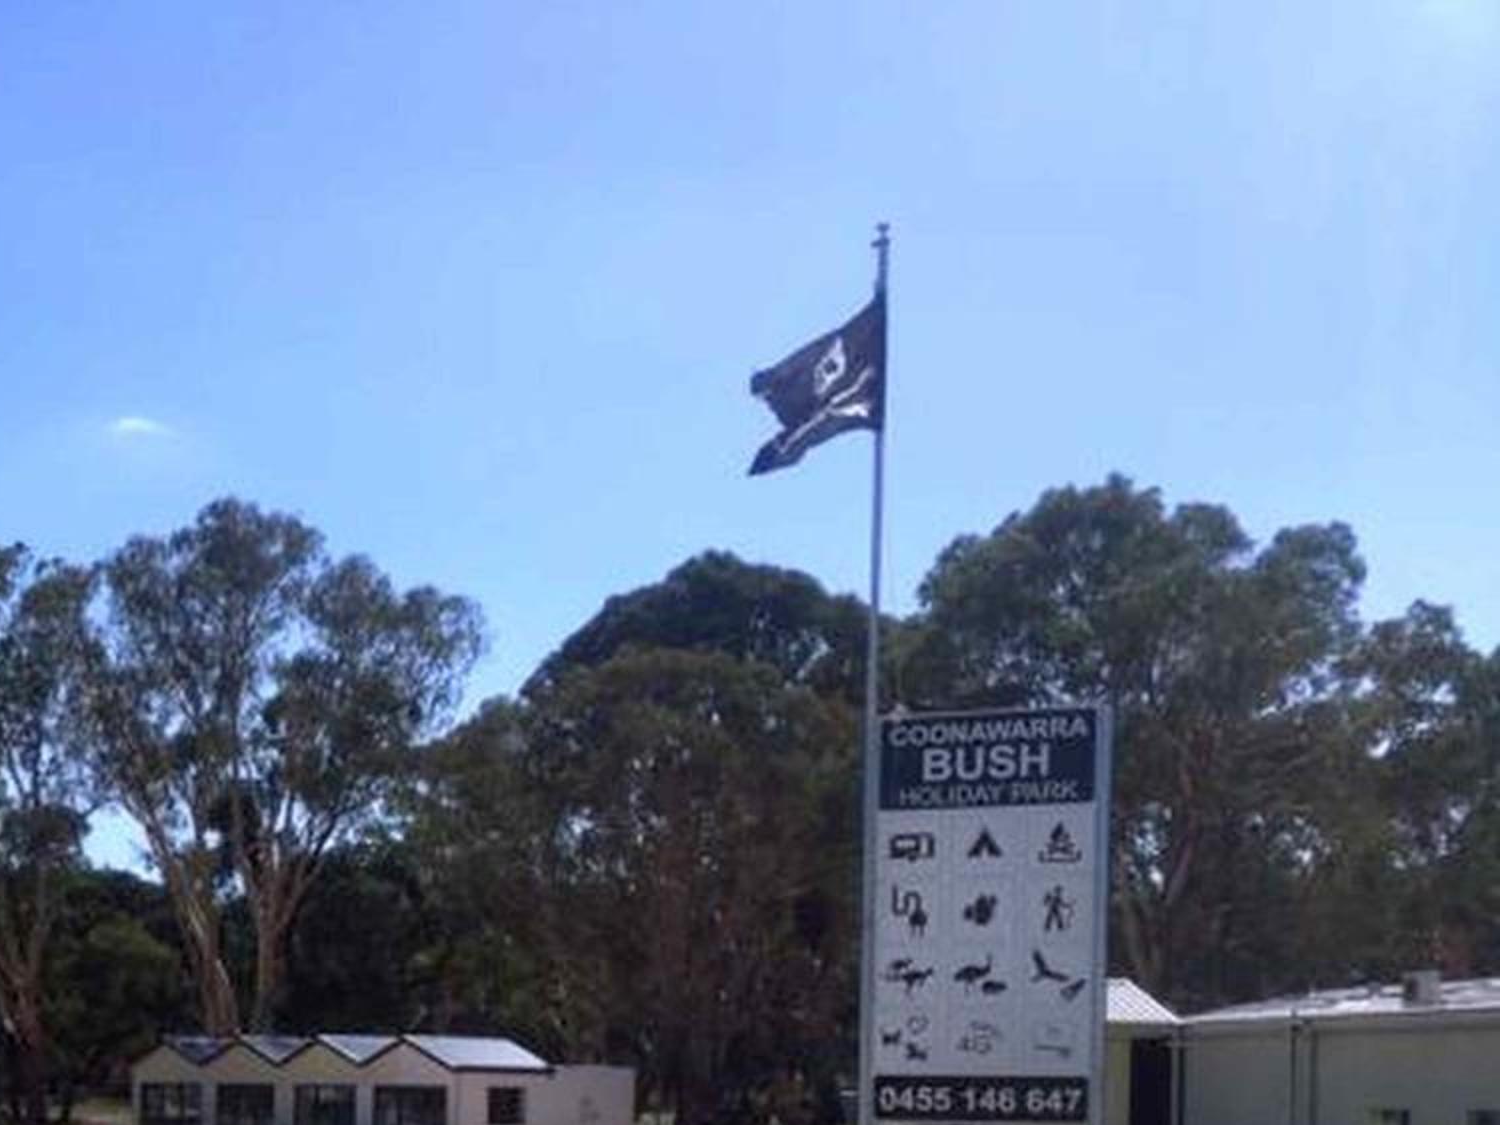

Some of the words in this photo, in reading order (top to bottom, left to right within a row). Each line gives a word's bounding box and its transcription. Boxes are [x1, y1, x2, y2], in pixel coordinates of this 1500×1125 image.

[890, 717, 1088, 747] COONAWARRA
[923, 743, 1049, 782] BUSH
[901, 783, 999, 806] HOLIDAY
[879, 1085, 950, 1112] 0455
[1026, 1088, 1081, 1112] 647
